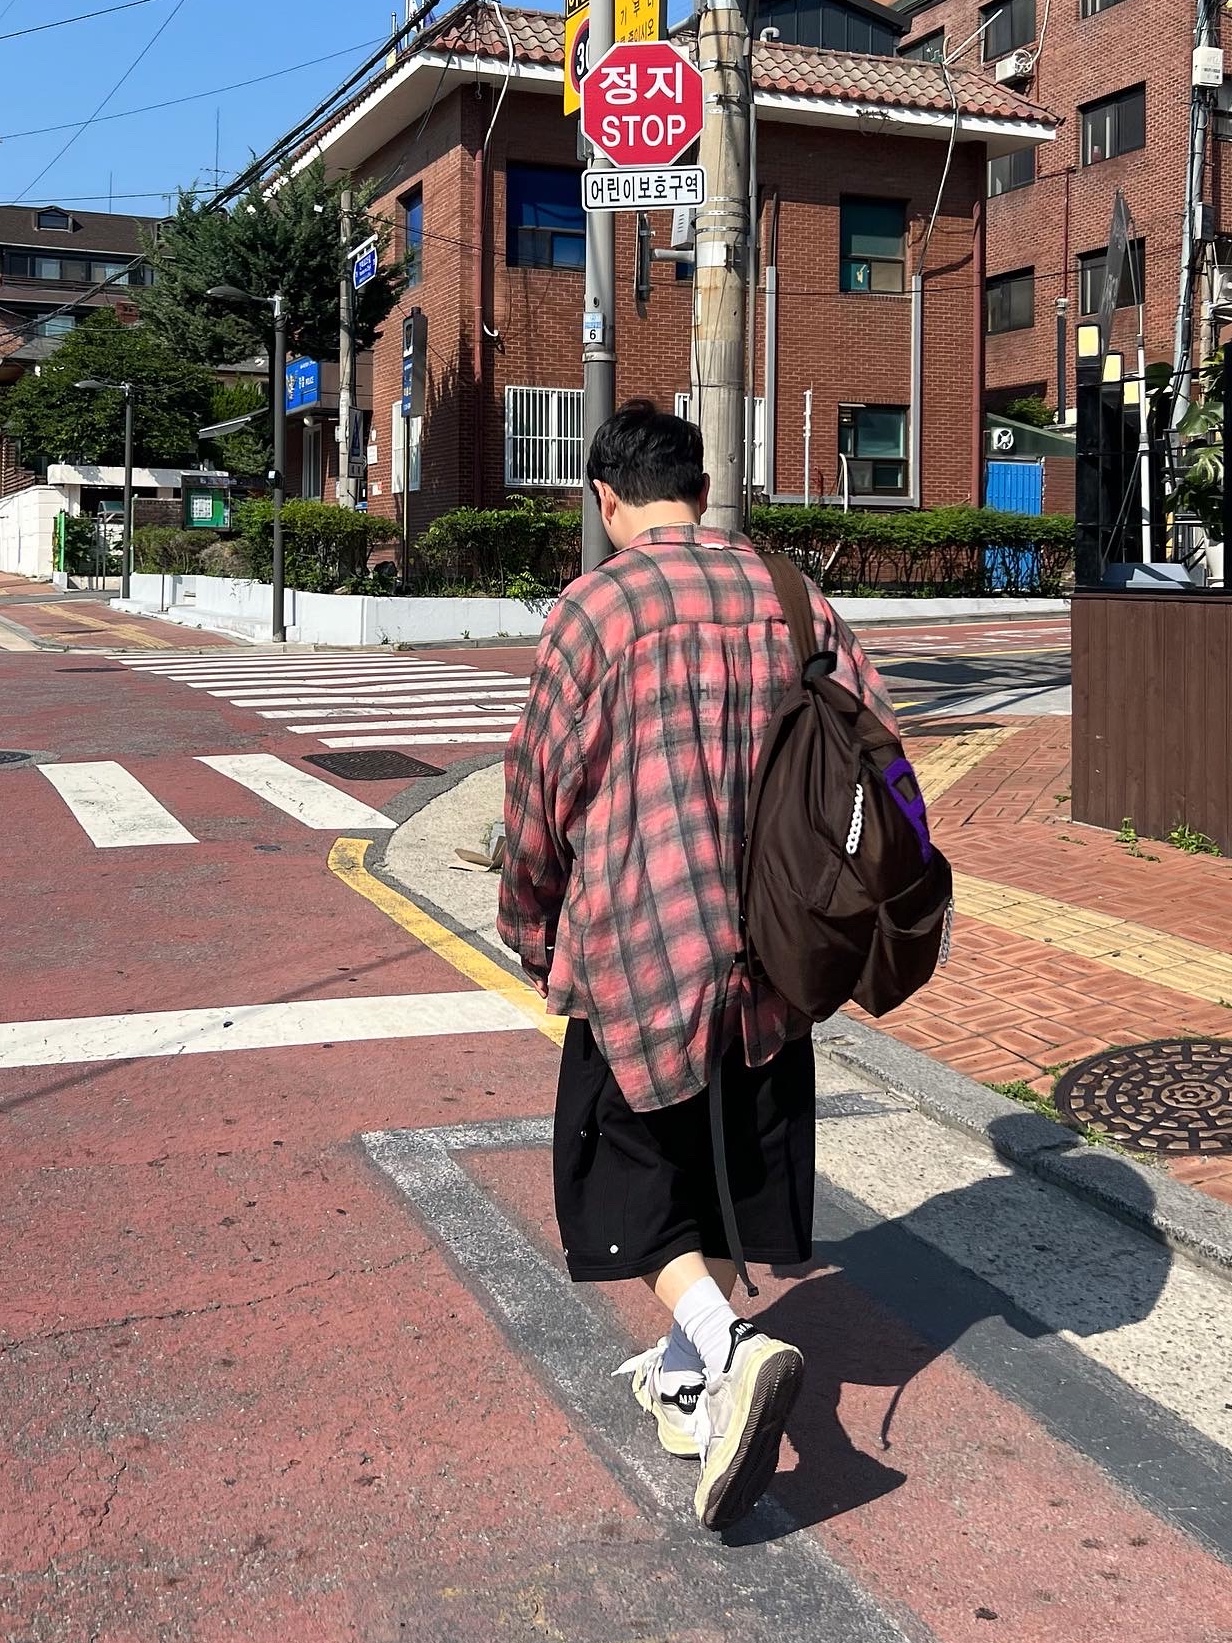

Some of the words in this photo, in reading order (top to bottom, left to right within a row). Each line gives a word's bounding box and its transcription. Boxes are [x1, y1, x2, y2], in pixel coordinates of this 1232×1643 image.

[576, 38, 590, 76] 3
[598, 61, 684, 105] 정지
[601, 114, 687, 148] STOP
[591, 173, 699, 203] 어린이보호구역
[589, 328, 597, 341] 6
